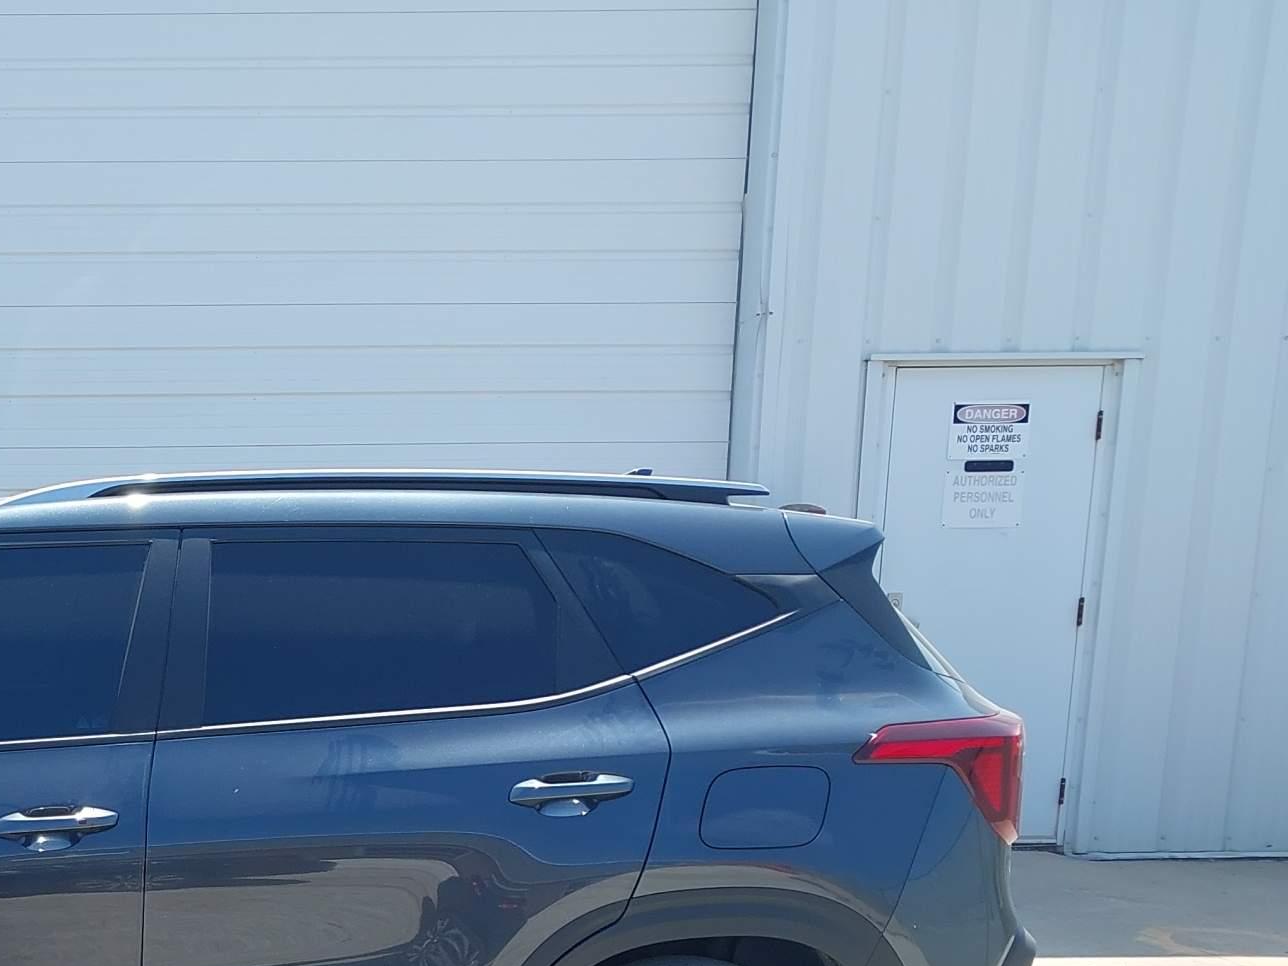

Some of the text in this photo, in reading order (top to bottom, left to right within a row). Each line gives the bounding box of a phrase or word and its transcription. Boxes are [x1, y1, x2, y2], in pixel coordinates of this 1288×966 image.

[965, 408, 1018, 419] DANGER
[967, 425, 1014, 433] NO SMOKING
[957, 434, 1021, 443] NO OPEN FLAMES
[967, 444, 1009, 453] NO SPARKS
[953, 475, 1017, 486] AUTHORIZED
[953, 491, 1014, 503] PERSONNEL
[968, 507, 996, 519] ONLY
